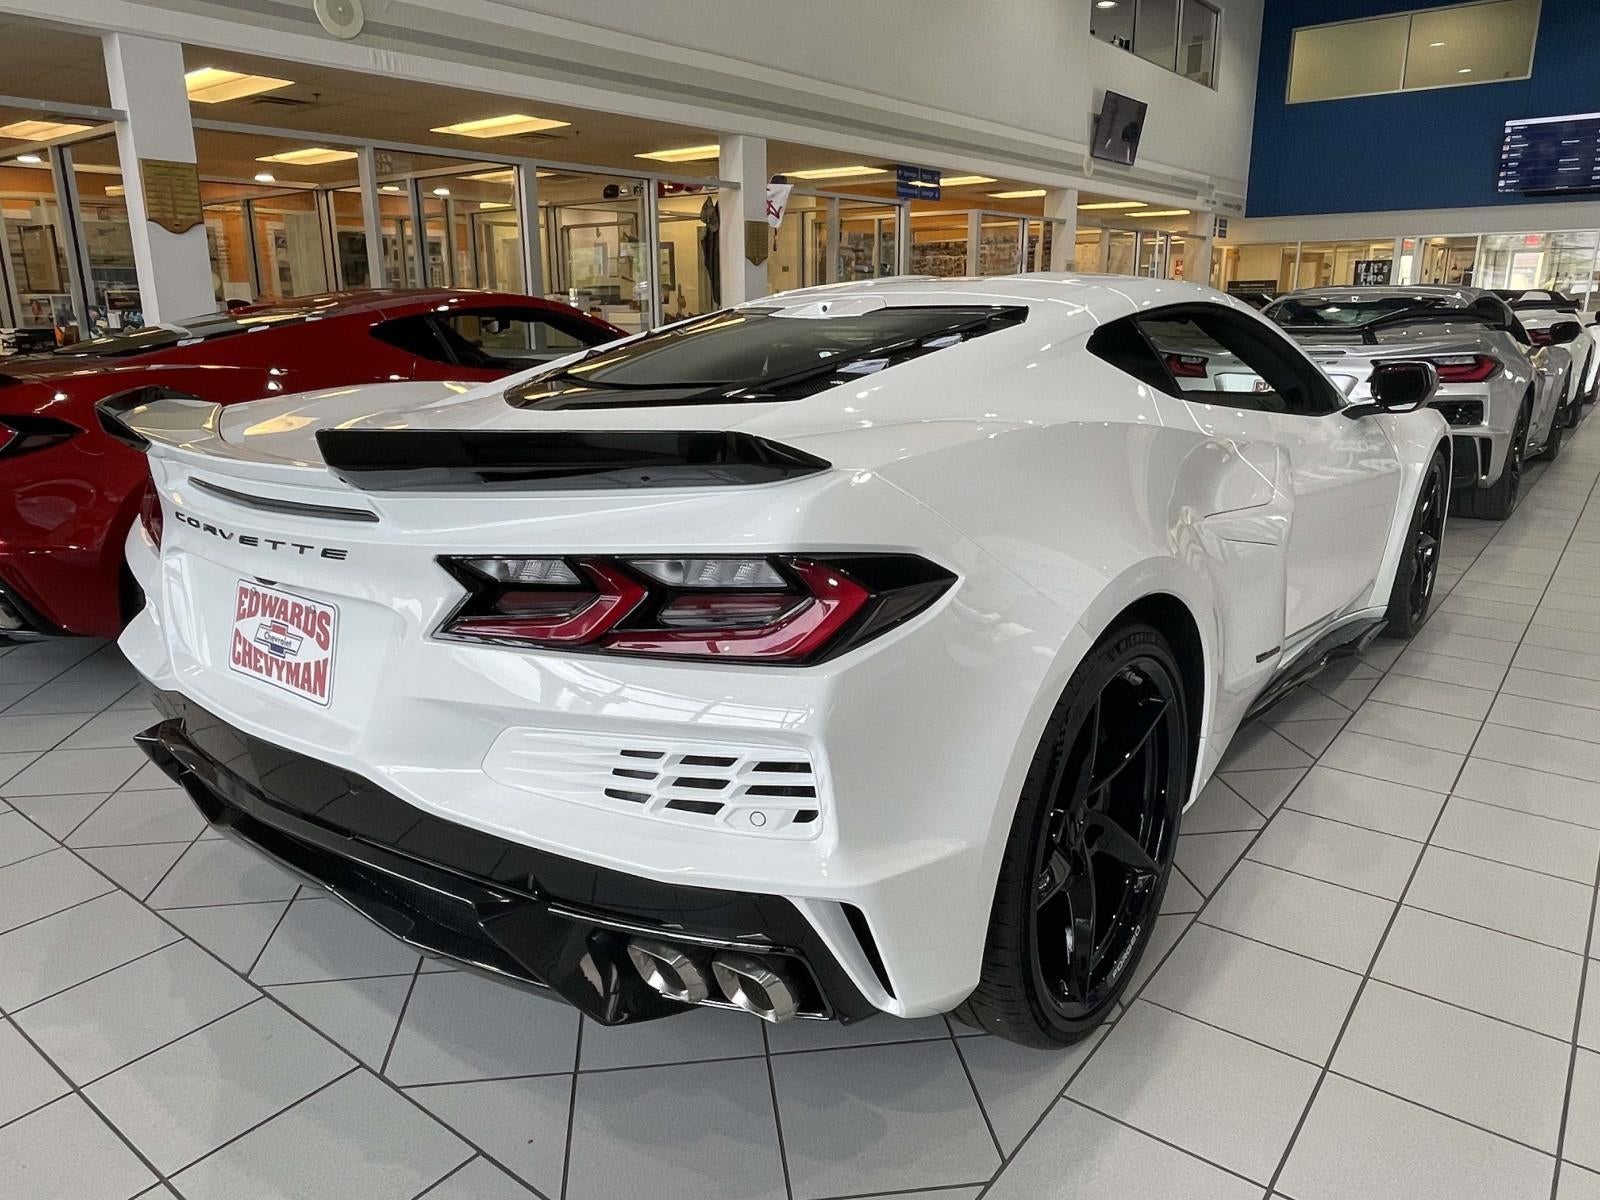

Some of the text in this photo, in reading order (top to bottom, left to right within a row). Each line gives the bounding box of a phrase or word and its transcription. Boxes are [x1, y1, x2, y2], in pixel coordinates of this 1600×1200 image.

[175, 511, 348, 561] CORVETTE
[236, 586, 331, 651] EDWARDS
[264, 631, 292, 647] Chevrolet
[232, 627, 329, 698] CHEVYMAN
